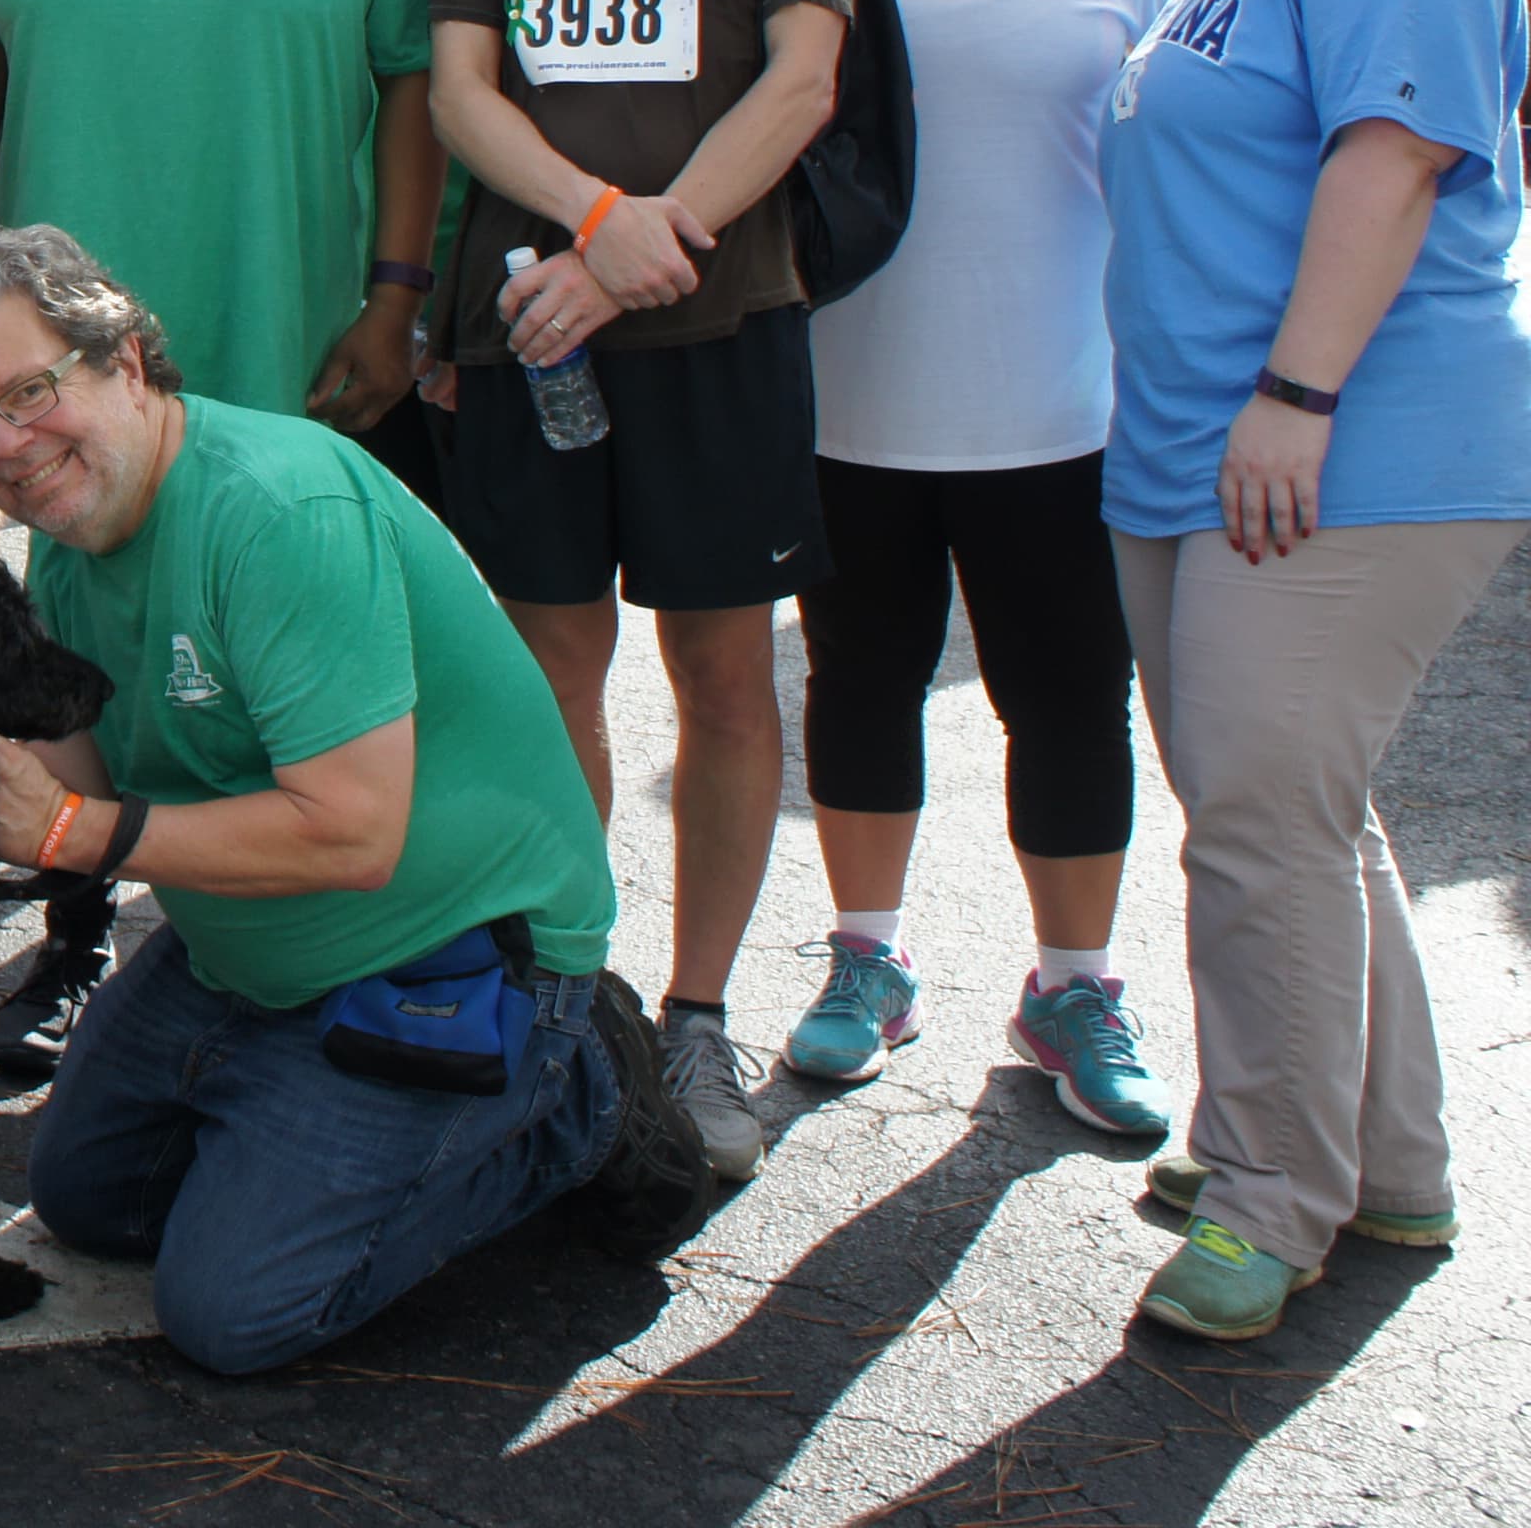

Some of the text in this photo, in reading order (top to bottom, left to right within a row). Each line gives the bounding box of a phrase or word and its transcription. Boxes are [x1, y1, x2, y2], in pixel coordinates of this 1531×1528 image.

[538, 60, 666, 71] www.precisionrace.com
[51, 805, 74, 834] WALK
[42, 833, 59, 855] FOR
